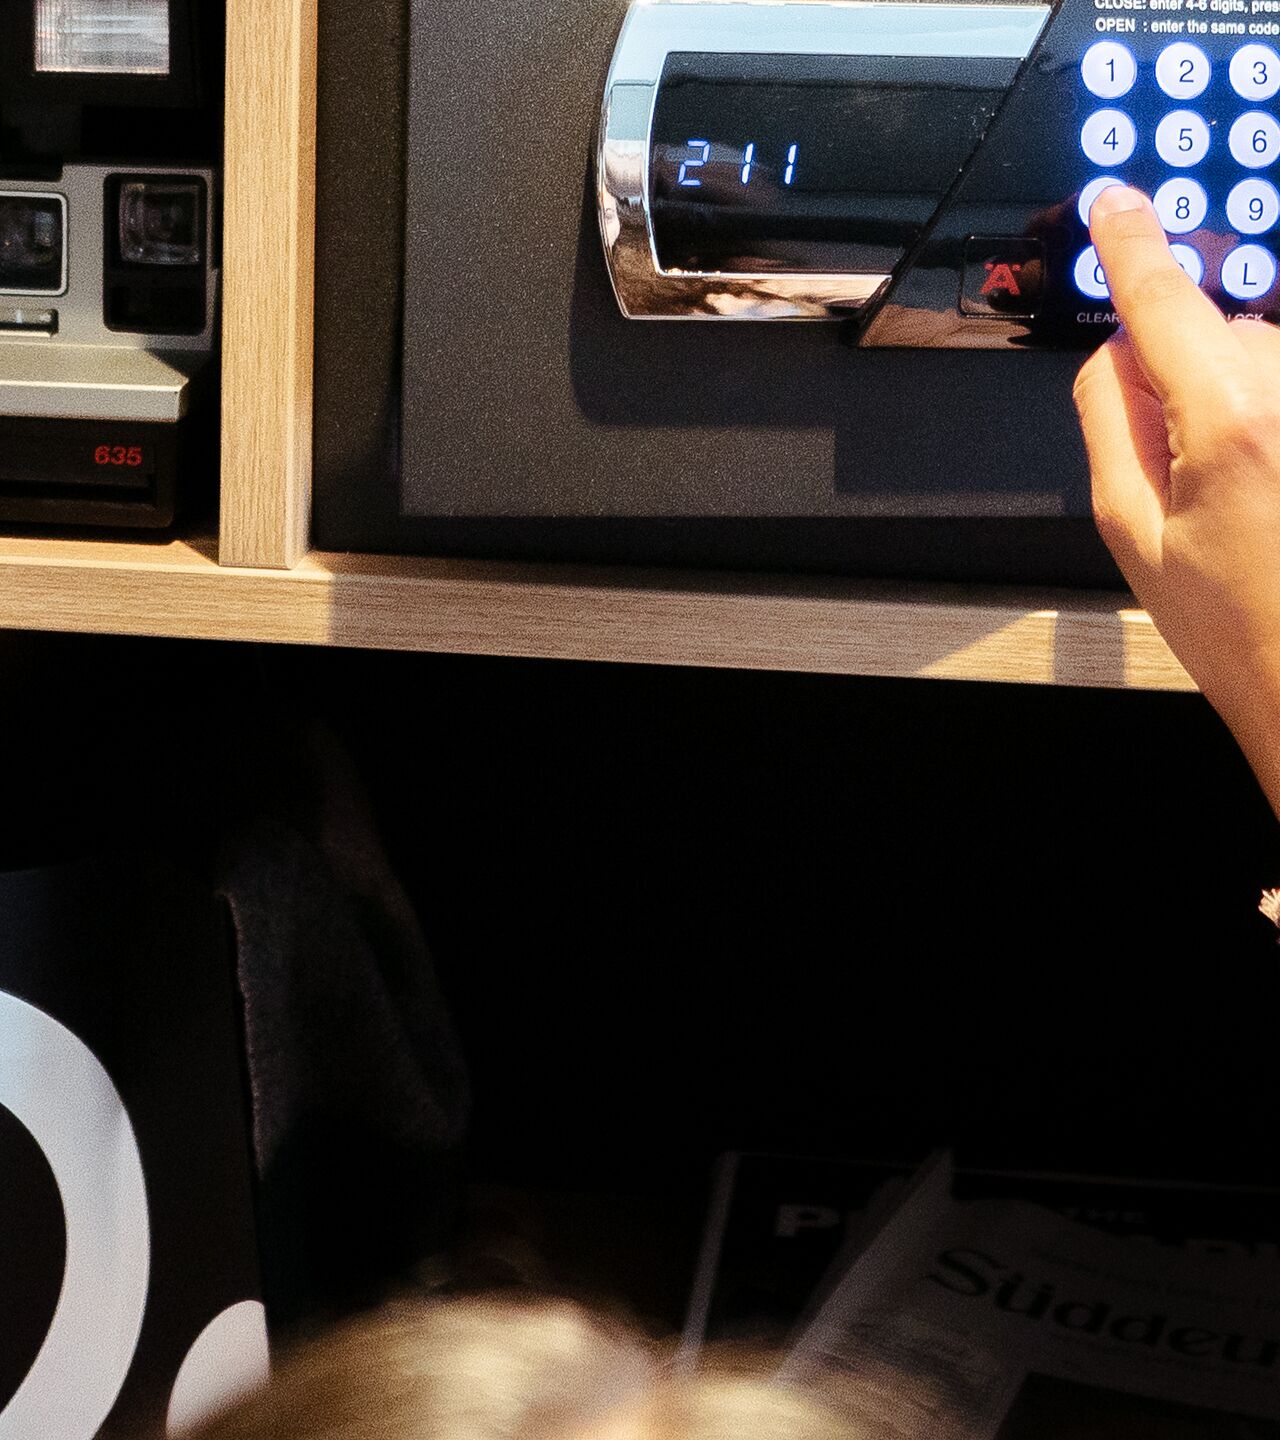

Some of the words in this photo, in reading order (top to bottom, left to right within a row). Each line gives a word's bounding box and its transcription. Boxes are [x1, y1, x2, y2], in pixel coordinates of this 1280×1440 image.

[1095, 18, 1135, 32] OPEN
[1151, 21, 1185, 33] enter
[1187, 20, 1207, 34] the
[1210, 22, 1245, 35] same
[1248, 21, 1280, 36] code
[1105, 59, 1116, 82] 1
[1179, 59, 1195, 83] 2
[1252, 61, 1268, 85] 3
[1103, 127, 1119, 151] 4
[1178, 128, 1194, 152] 5
[1252, 129, 1268, 153] 6
[677, 139, 798, 186] 211
[1175, 196, 1191, 220] 8
[1248, 197, 1264, 221] 9
[1242, 262, 1258, 286] L
[1076, 312, 1121, 324] CLEAR
[94, 445, 143, 467] 635
